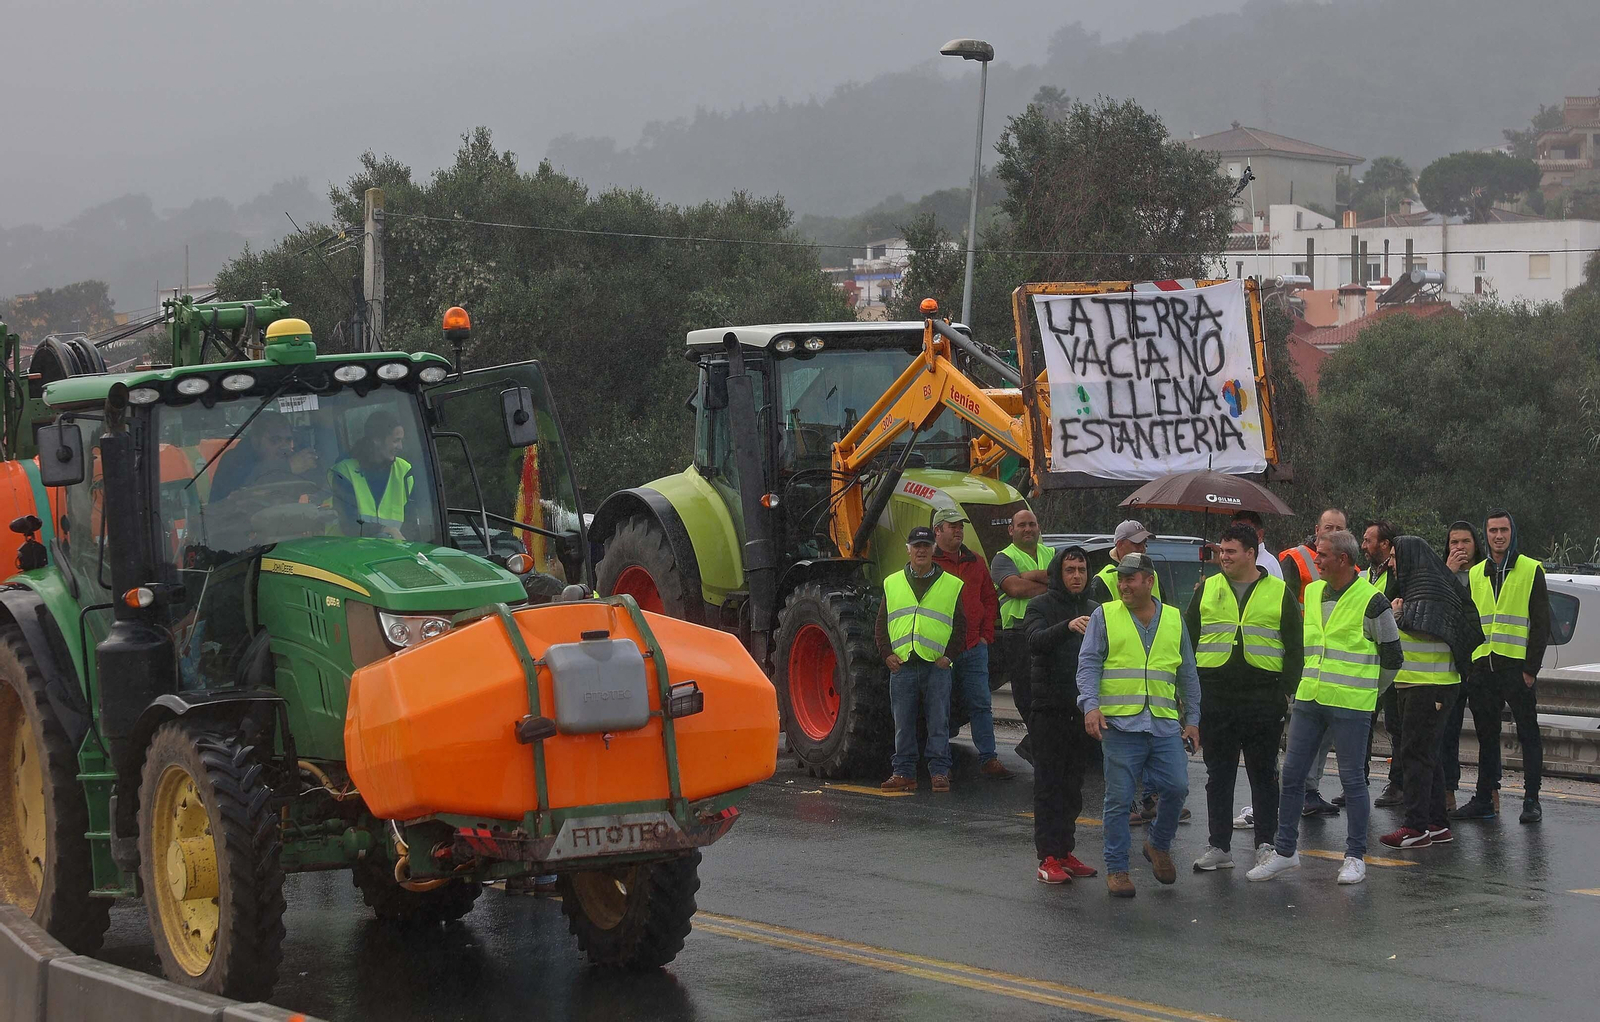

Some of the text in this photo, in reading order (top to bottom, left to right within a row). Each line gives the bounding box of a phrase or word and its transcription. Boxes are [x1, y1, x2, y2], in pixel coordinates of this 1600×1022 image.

[1044, 294, 1223, 340] LA TIERRA
[1055, 330, 1226, 380] VACIA NO
[923, 385, 932, 397] B3
[950, 385, 980, 415] tenías
[1105, 376, 1222, 420] LLENA
[1060, 414, 1246, 461] ESTANTERIA
[903, 481, 937, 500] CLAAS
